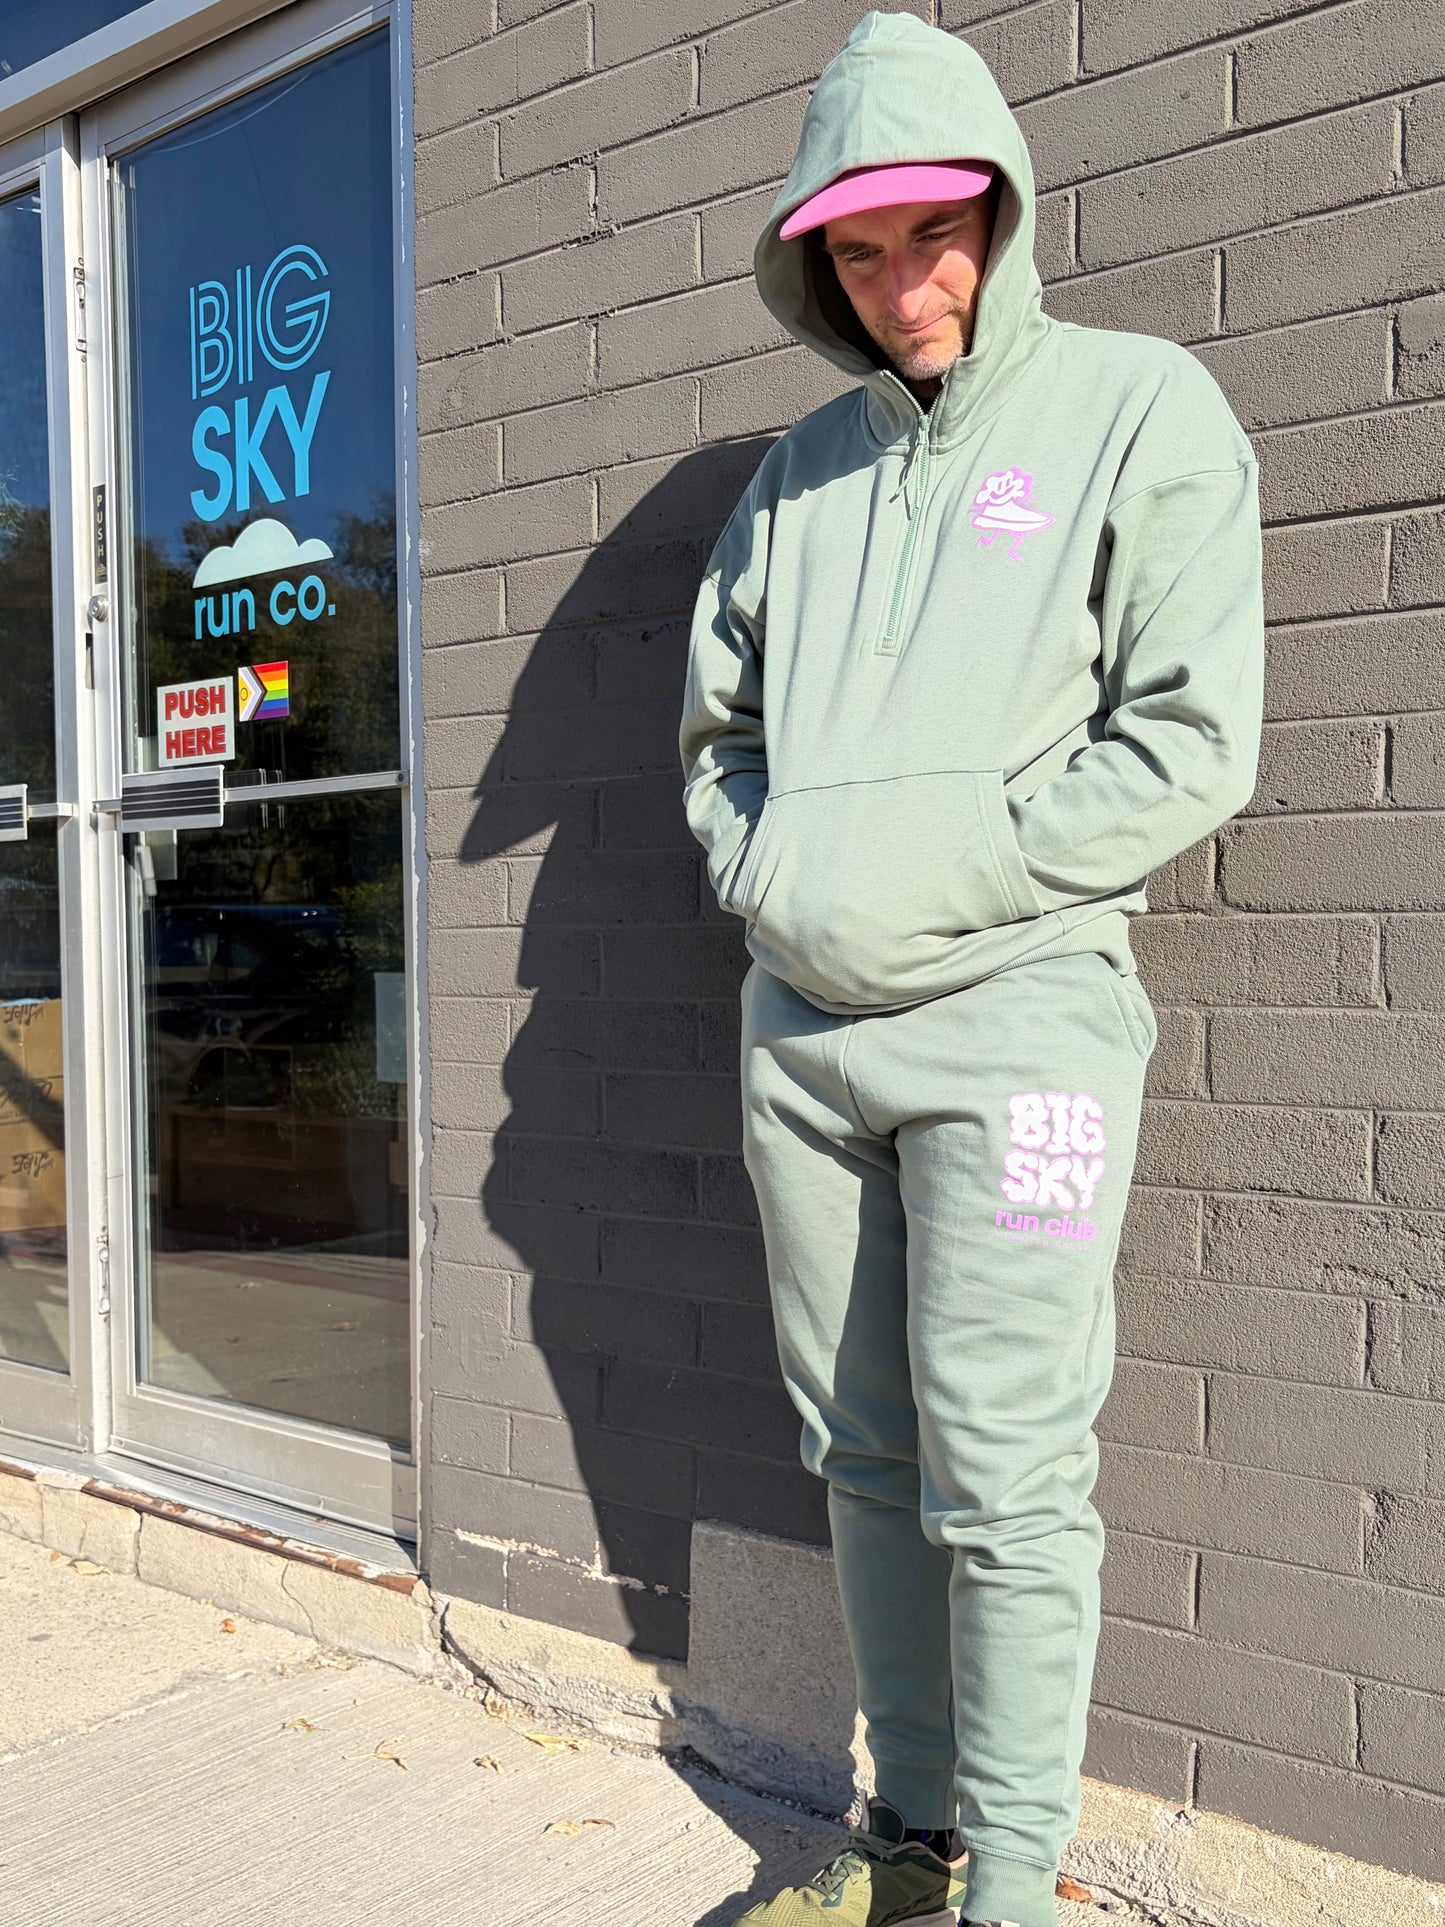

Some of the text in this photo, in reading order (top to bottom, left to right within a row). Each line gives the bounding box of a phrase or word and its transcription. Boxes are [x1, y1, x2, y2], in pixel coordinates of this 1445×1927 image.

[190, 244, 330, 400] BIG
[190, 370, 331, 522] SKY
[96, 494, 104, 557] PUSH
[194, 575, 336, 641] run co.
[164, 684, 226, 721] PUSH
[165, 724, 227, 760] HERE
[1008, 1091, 1107, 1156] BIG
[1000, 1149, 1106, 1212] SKY
[995, 1210, 1040, 1233] run
[1044, 1215, 1097, 1242] club
